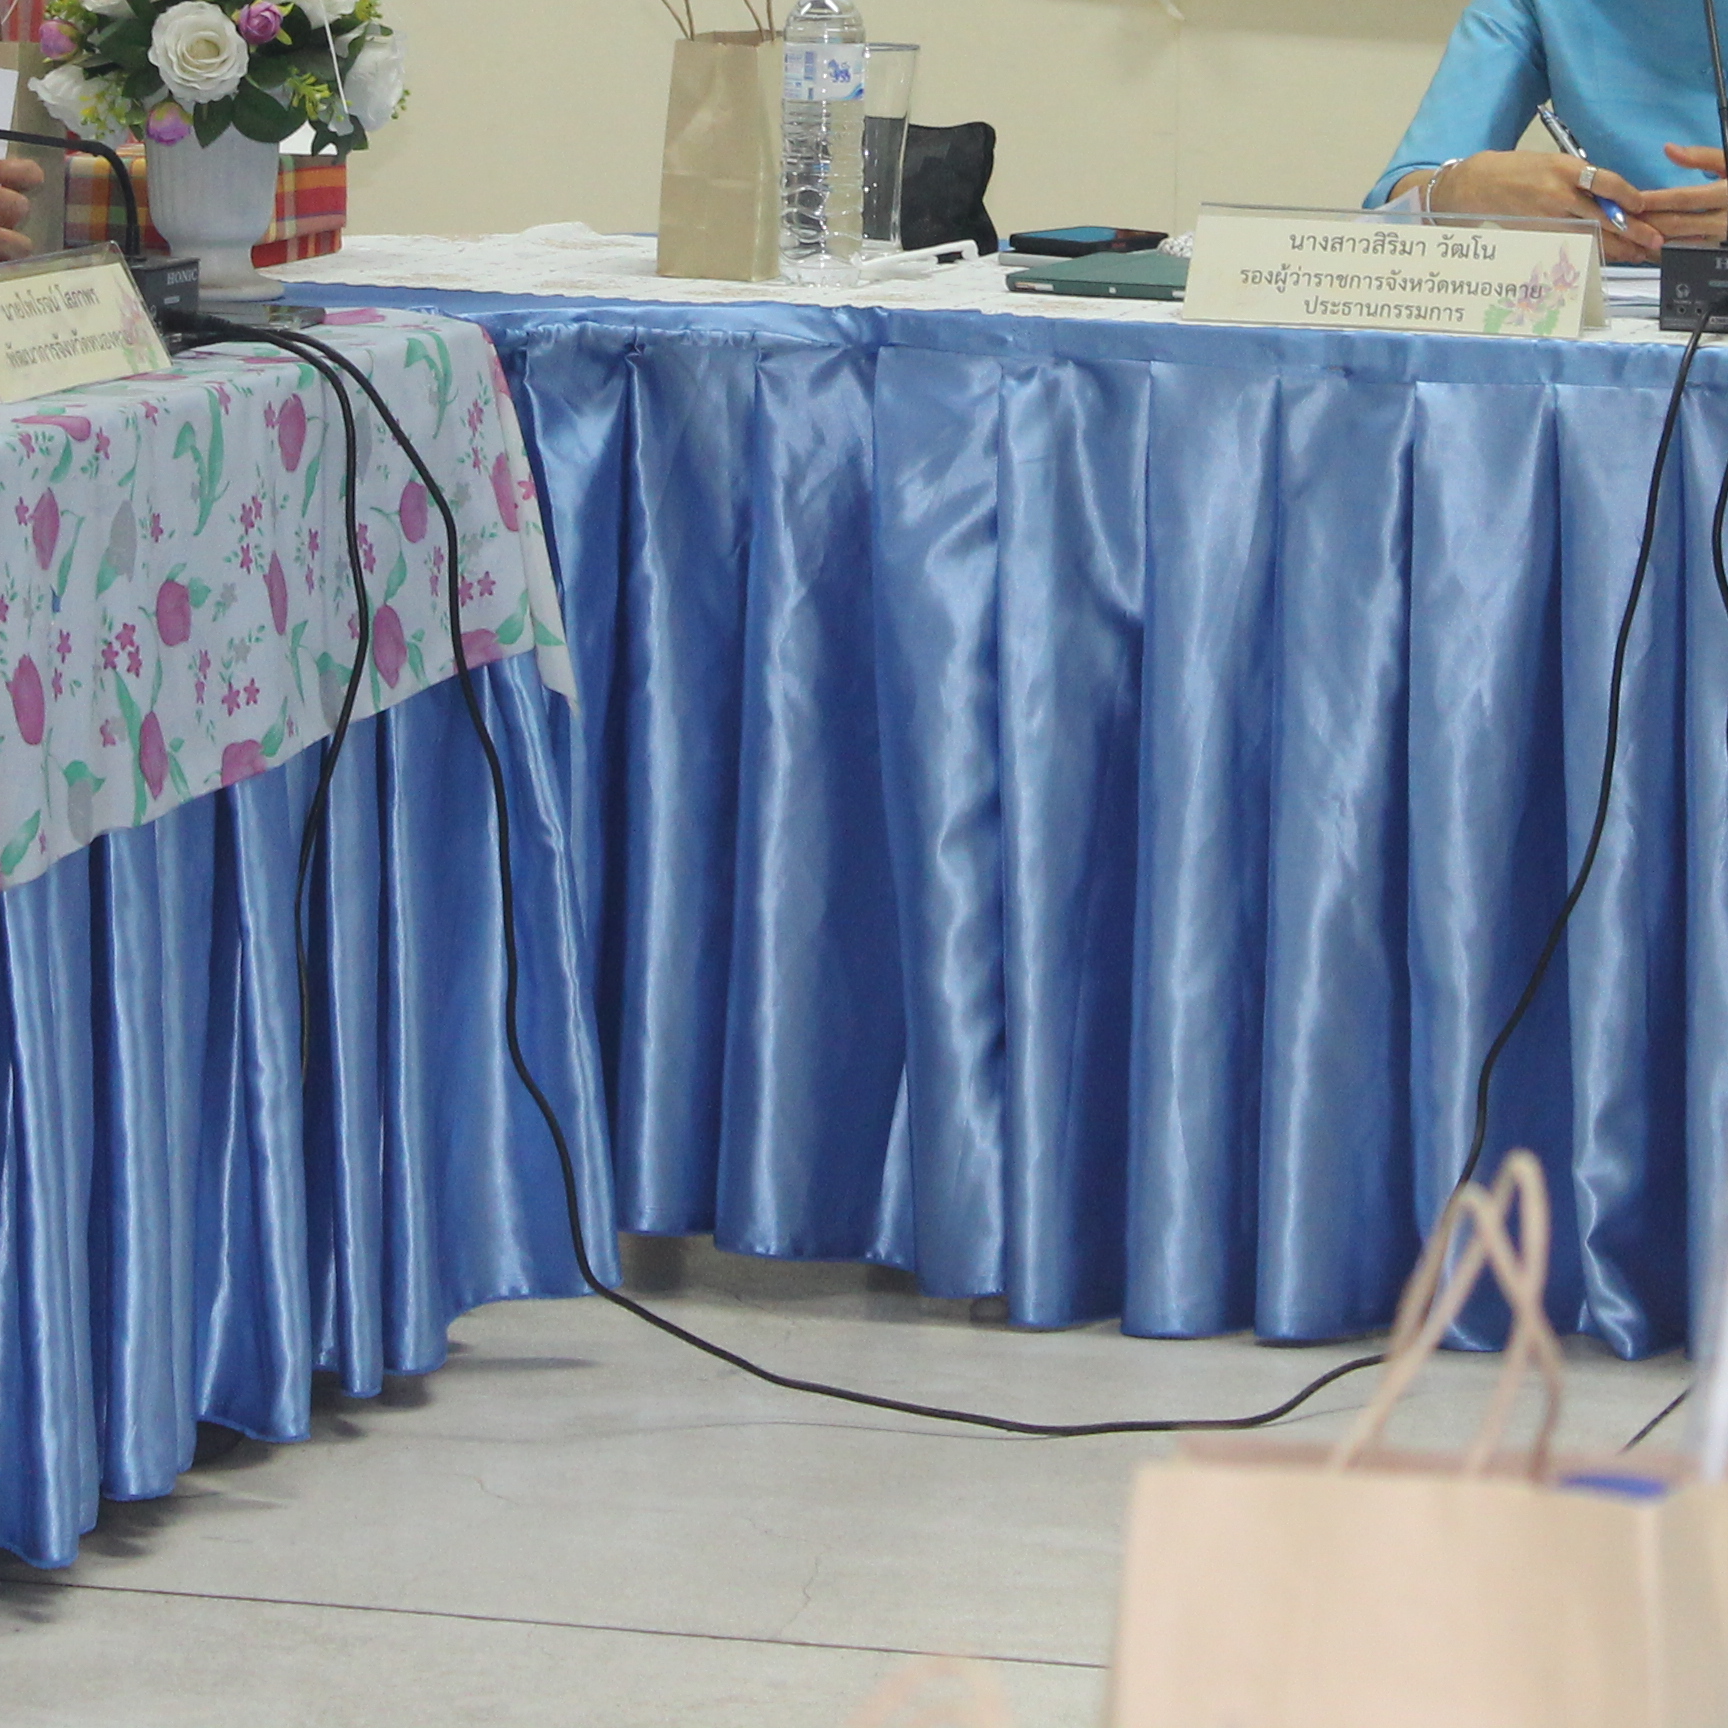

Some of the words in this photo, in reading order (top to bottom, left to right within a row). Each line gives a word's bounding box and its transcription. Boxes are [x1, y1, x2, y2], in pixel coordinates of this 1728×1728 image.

[1290, 231, 1427, 258] นางสาวสิริมา
[1436, 231, 1498, 261] วัฒโน
[1239, 266, 1544, 300] รองผู้ว่าราชการจังหวัดหนองคาย
[1303, 296, 1466, 324] ประธานกรรมการ
